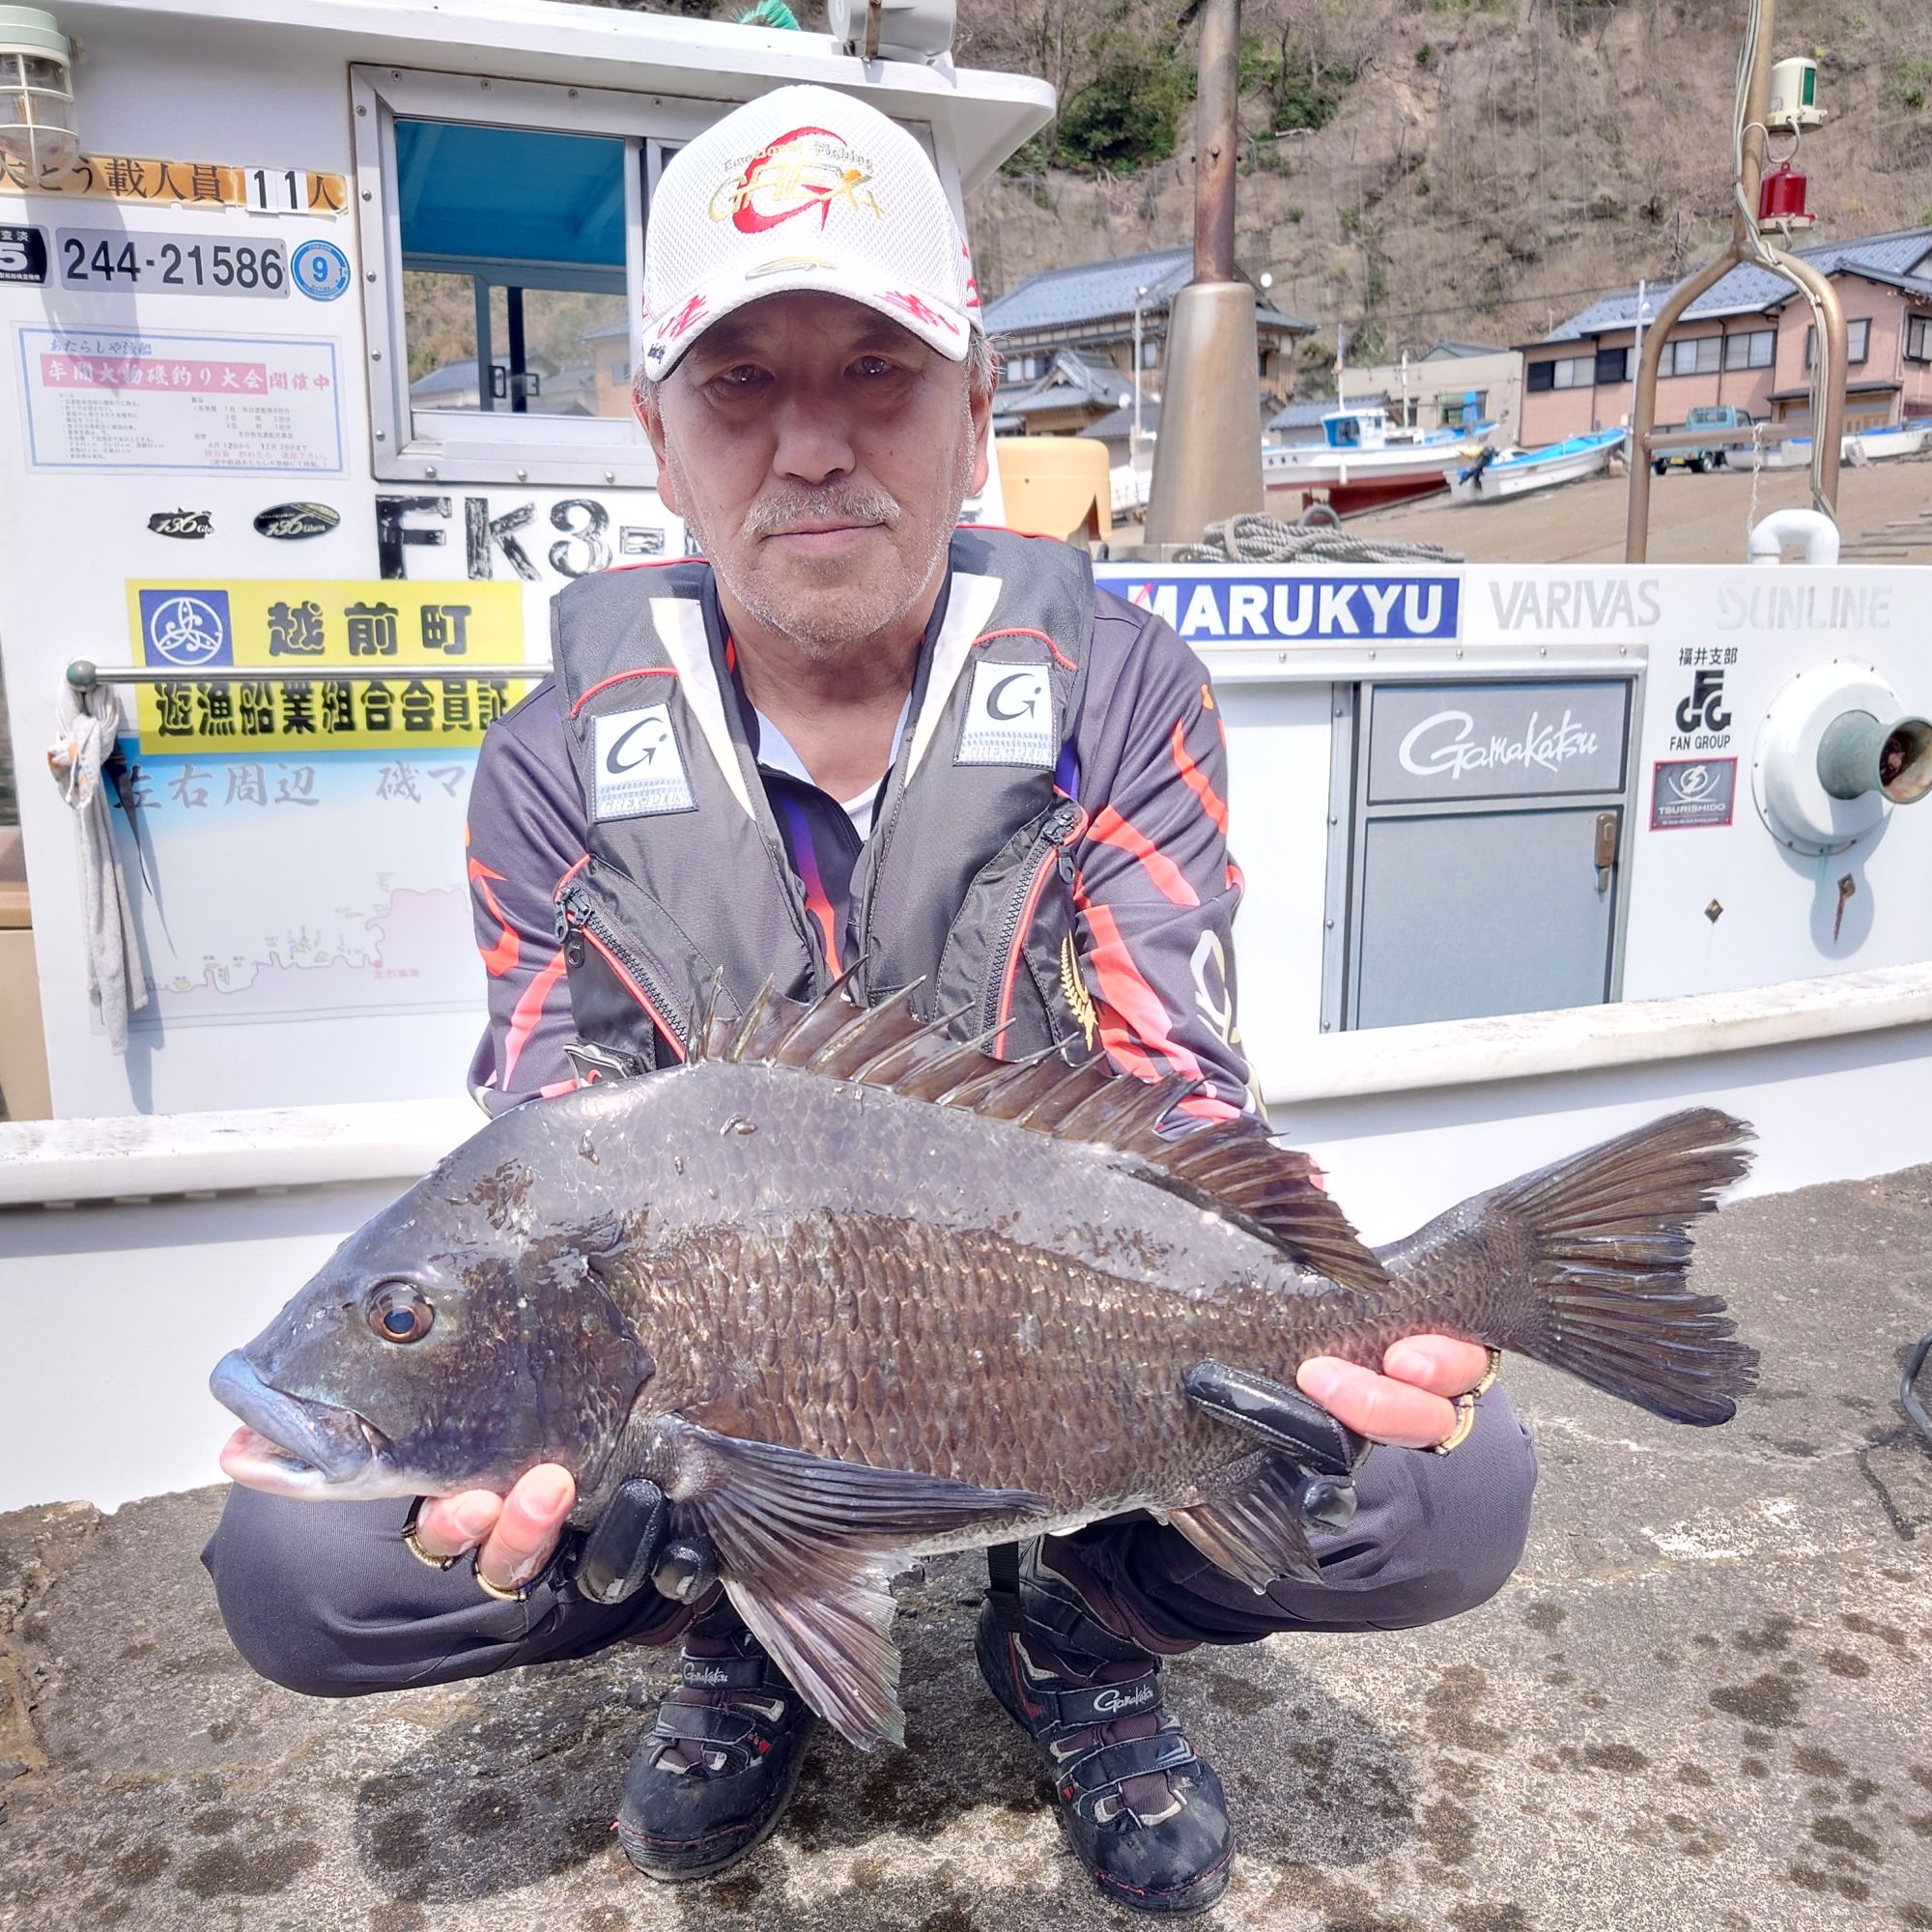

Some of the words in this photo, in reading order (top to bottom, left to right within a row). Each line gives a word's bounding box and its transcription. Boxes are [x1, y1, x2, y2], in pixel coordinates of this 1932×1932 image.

[64, 238, 284, 290] 244-21586
[312, 256, 328, 283] 9
[1127, 583, 1443, 637] MARUKYU
[1489, 579, 1662, 631] VARIVAS
[267, 601, 472, 658] 越前町
[1678, 647, 1739, 667] 福井支部
[1398, 709, 1600, 780] Gamakatsu
[1669, 736, 1691, 751] FAN
[1695, 735, 1731, 750] GROUP
[1658, 803, 1726, 815] TSURISHIDO
[683, 1662, 728, 1687] Gamakatsu
[1093, 1684, 1154, 1713] Gamakatsu
